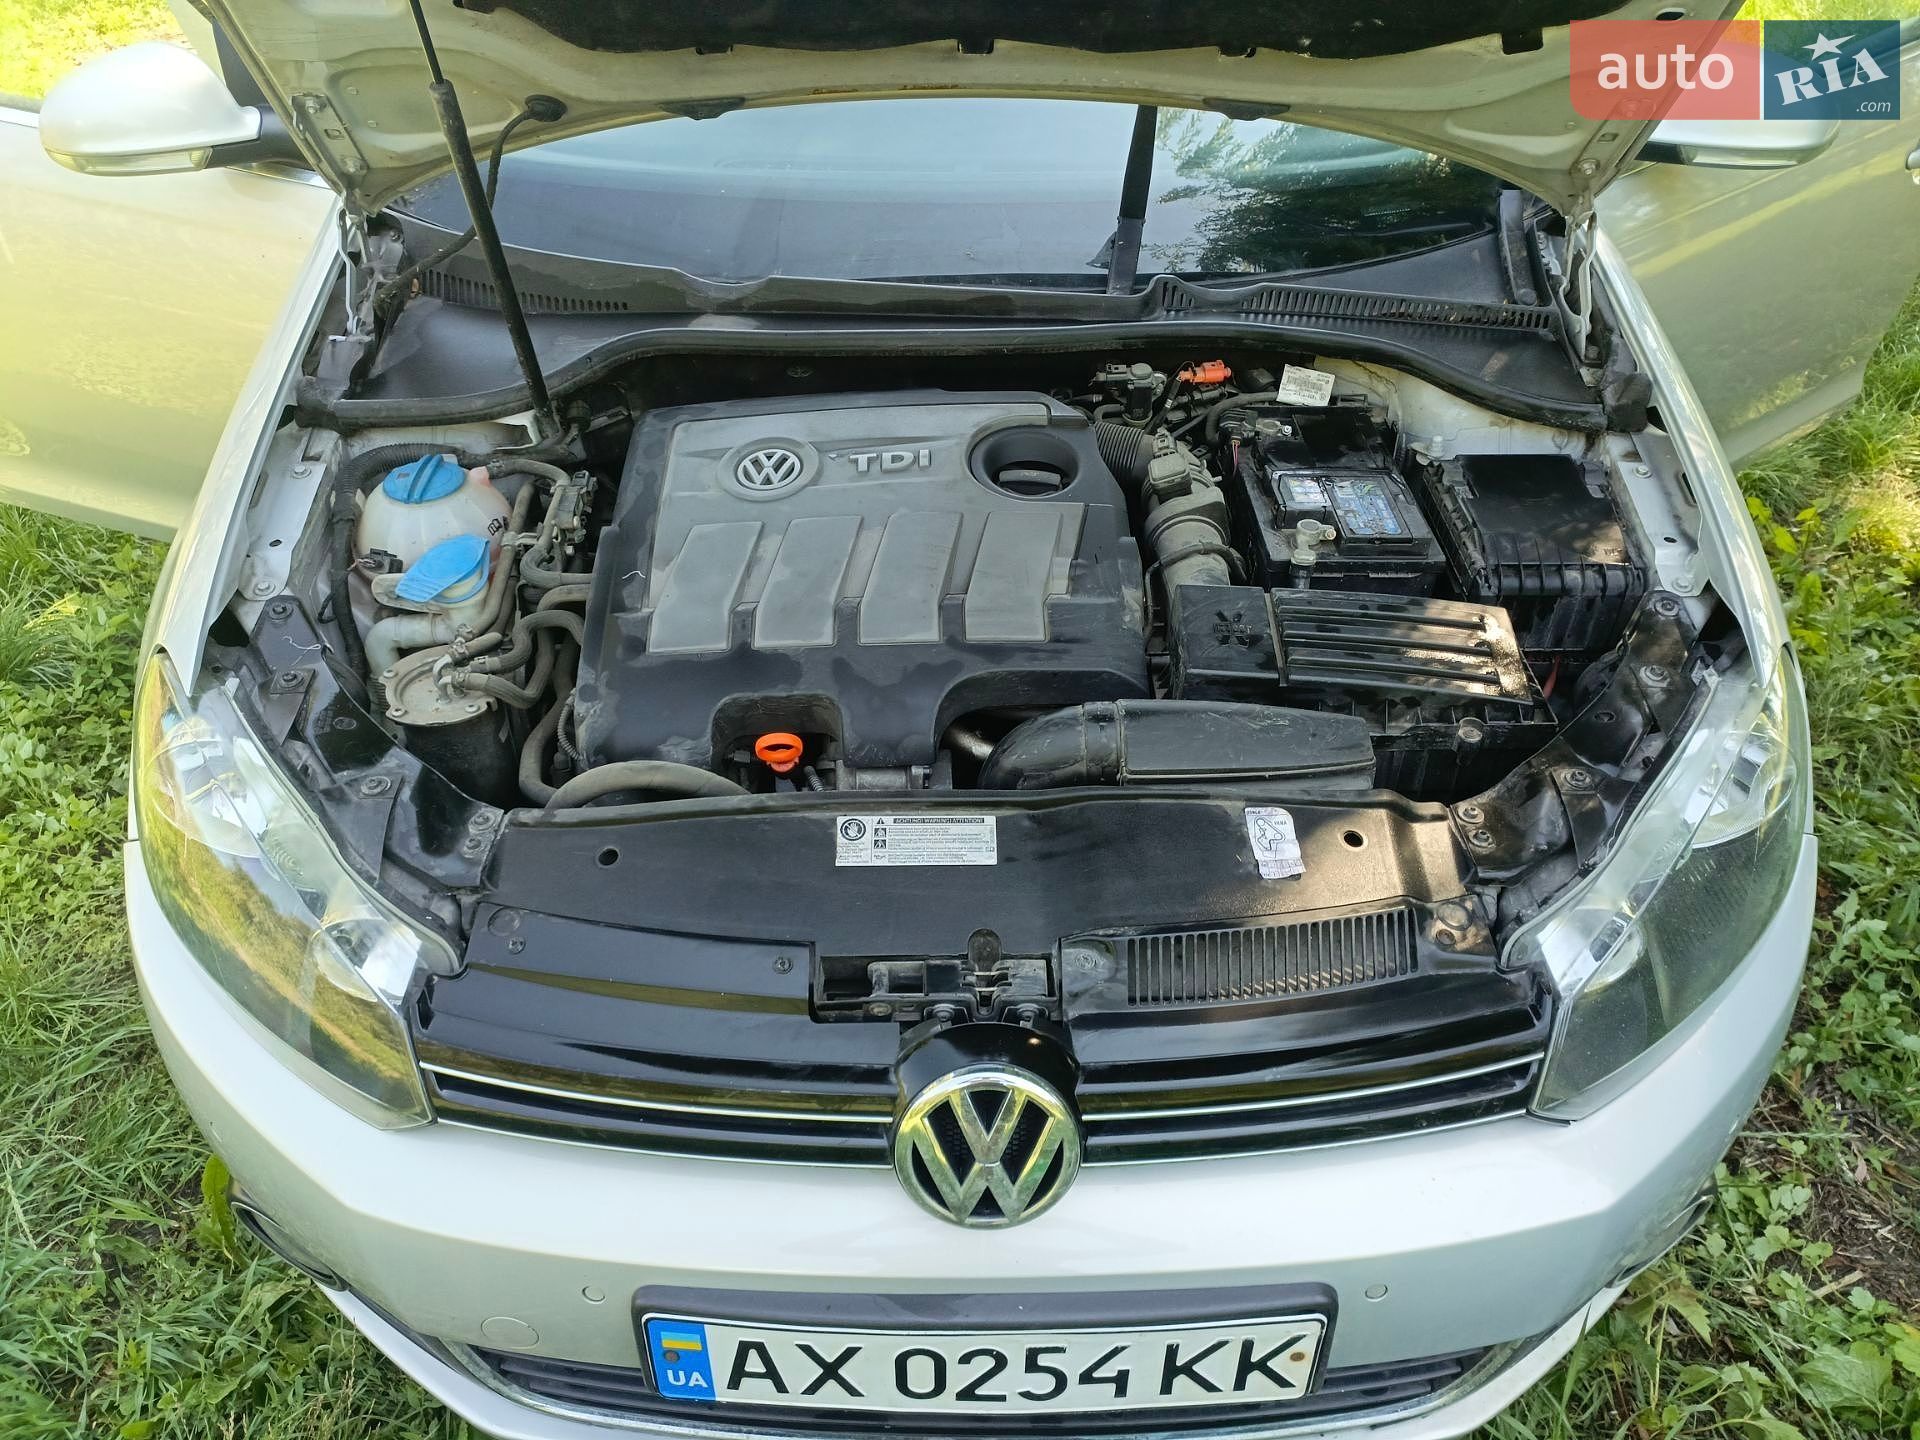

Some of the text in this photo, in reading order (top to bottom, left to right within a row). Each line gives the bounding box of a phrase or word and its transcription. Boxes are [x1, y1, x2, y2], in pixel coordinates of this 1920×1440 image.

[849, 449, 932, 473] TDI
[666, 1369, 708, 1388] UA
[726, 1333, 1308, 1402] AX 0254 KK
